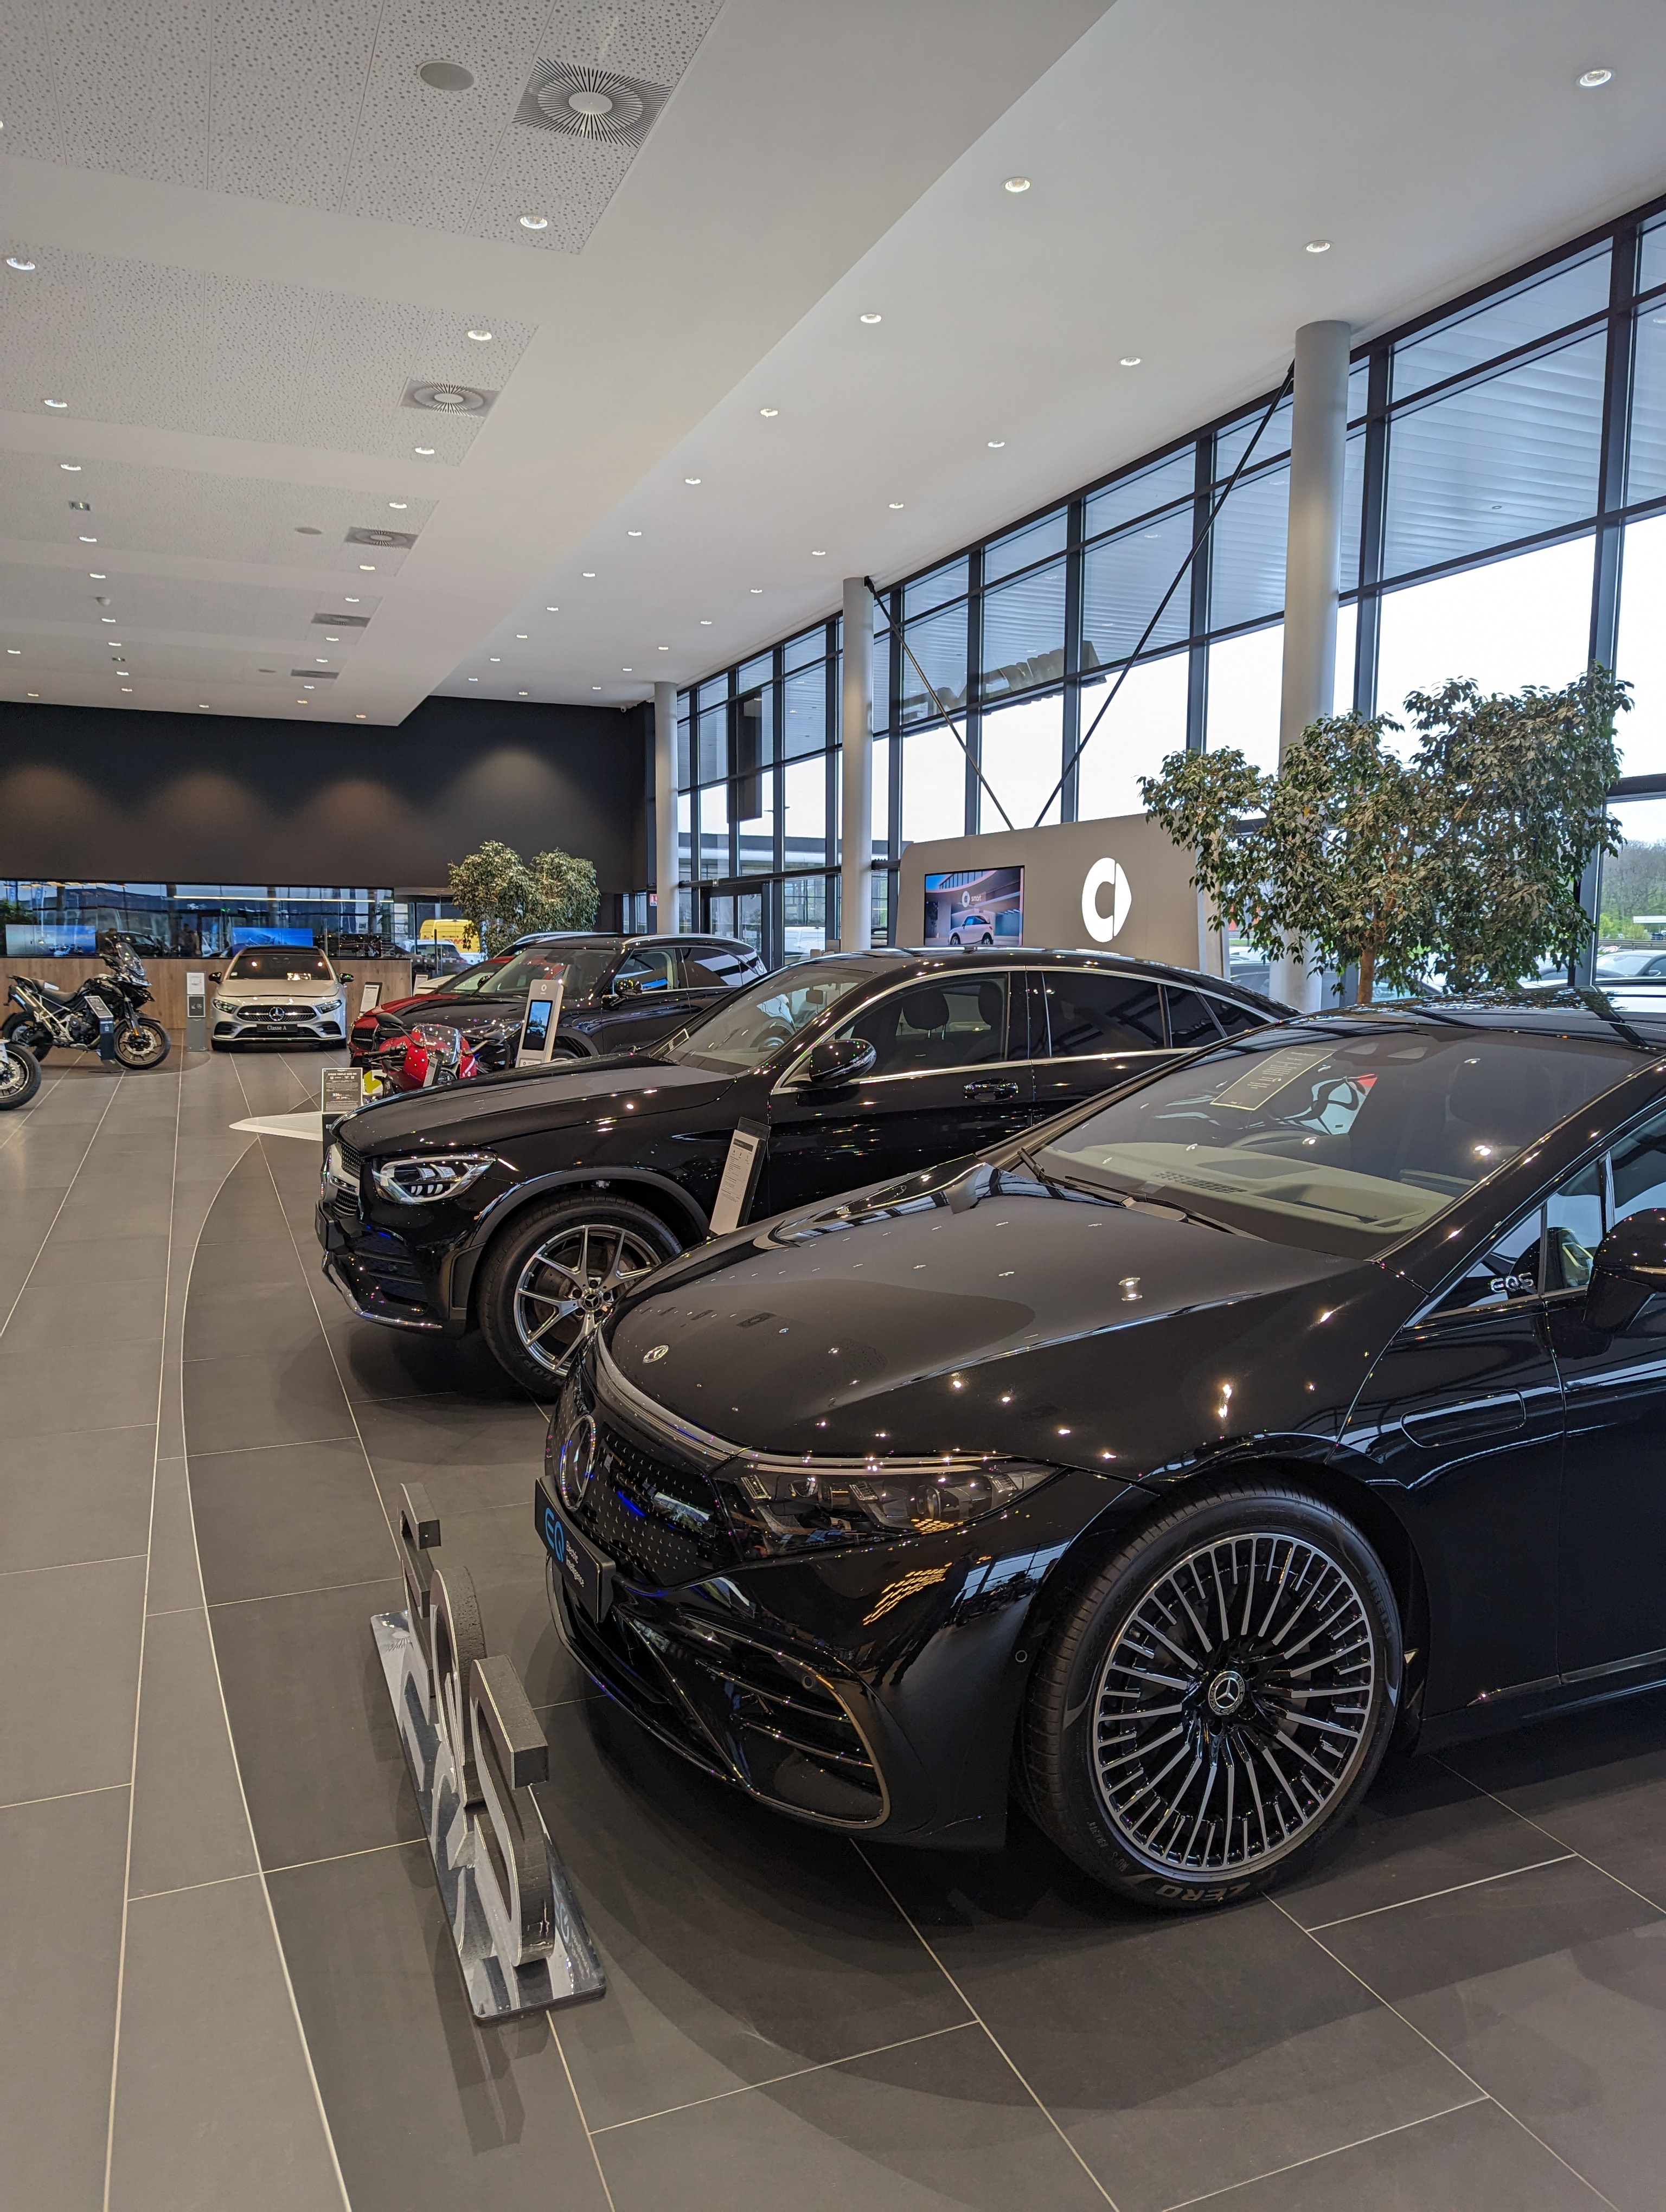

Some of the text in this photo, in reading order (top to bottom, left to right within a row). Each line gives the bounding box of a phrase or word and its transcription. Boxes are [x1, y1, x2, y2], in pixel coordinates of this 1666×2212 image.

[1490, 1272, 1534, 1294] EQS
[545, 1507, 565, 1562] EQ
[566, 1540, 579, 1564] Electric
[566, 1555, 585, 1587] Intelligence
[1210, 1687, 1221, 1712] MERCEDES
